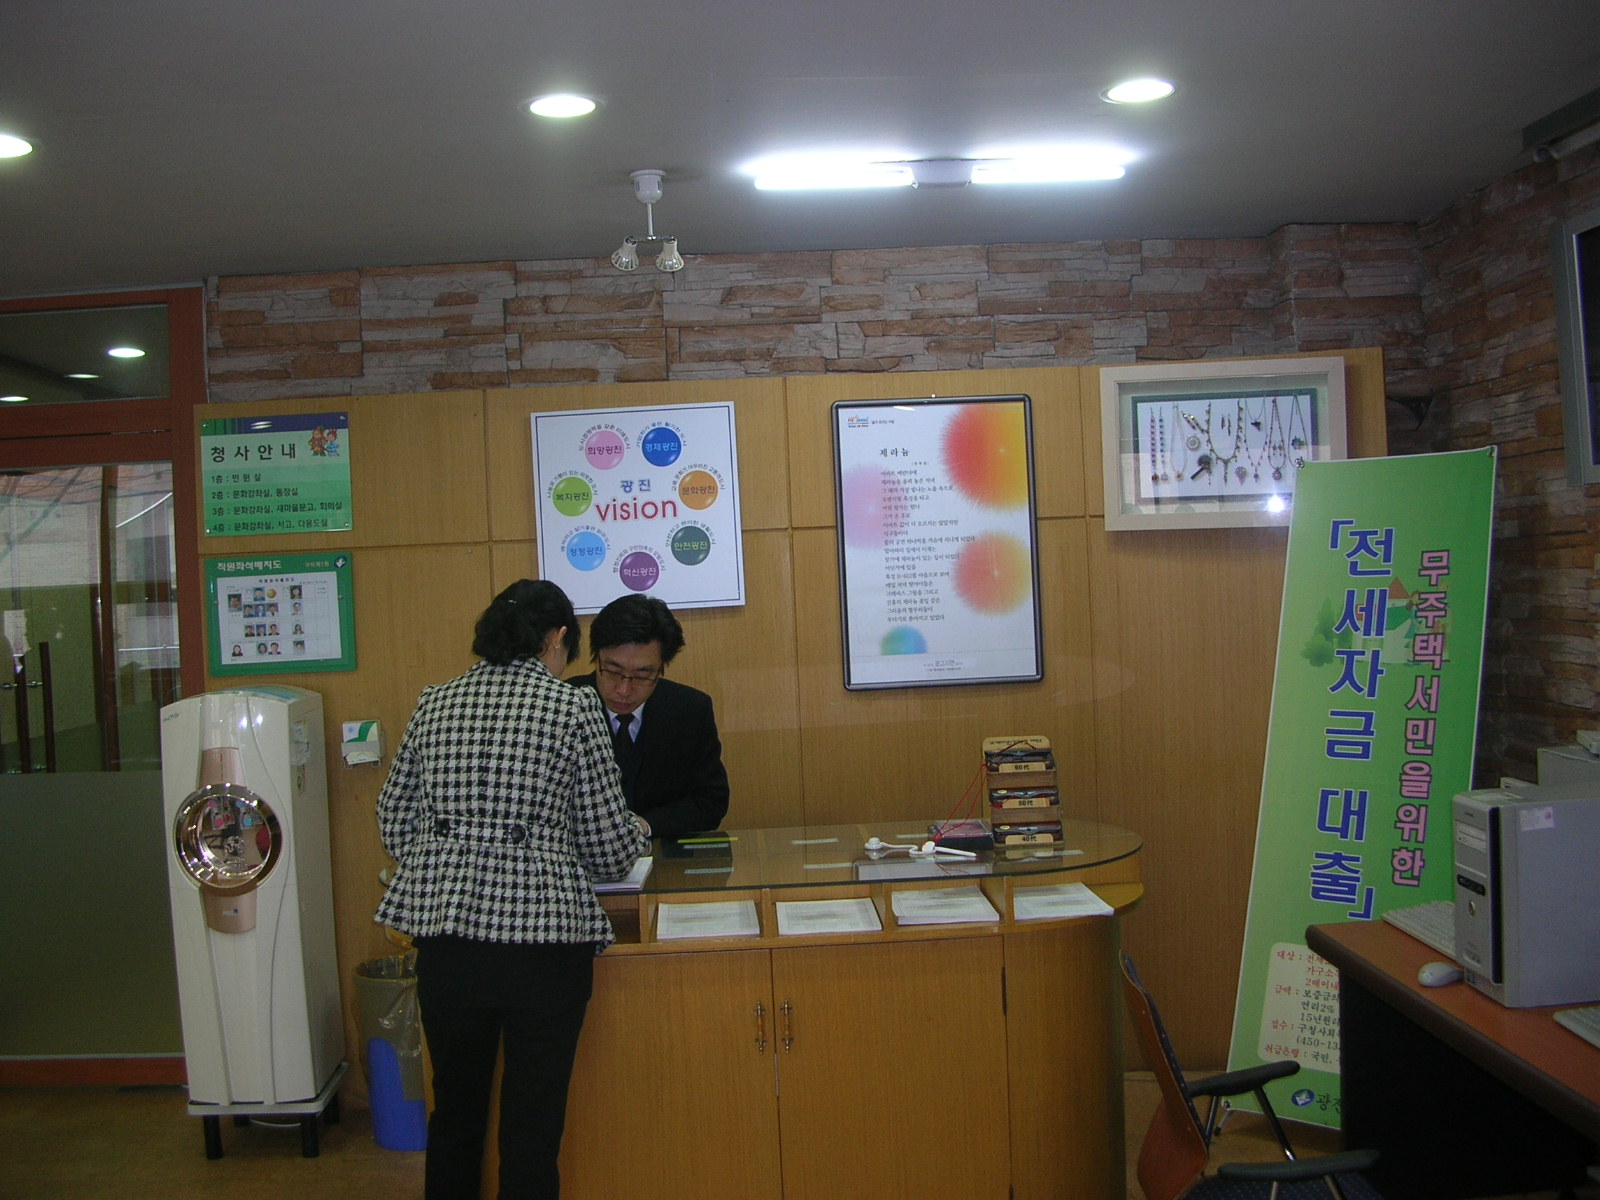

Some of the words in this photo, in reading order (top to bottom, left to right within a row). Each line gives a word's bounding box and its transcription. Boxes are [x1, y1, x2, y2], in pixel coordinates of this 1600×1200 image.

[587, 445, 622, 455] 희망광진
[645, 442, 678, 453] 경제광진
[879, 447, 910, 458] 제라늄
[620, 478, 651, 494] 광진
[682, 486, 715, 496] 문화광진
[556, 492, 589, 502] 복지광진
[595, 497, 678, 522] vision
[674, 541, 708, 551] 안전광진
[217, 560, 282, 572] 직원좌석배치도
[623, 568, 657, 577] 혁신광진
[1277, 950, 1295, 962] 대상
[1274, 984, 1292, 996] 금액
[1270, 1018, 1288, 1030] 접수
[1264, 1042, 1300, 1058] 취급은행
